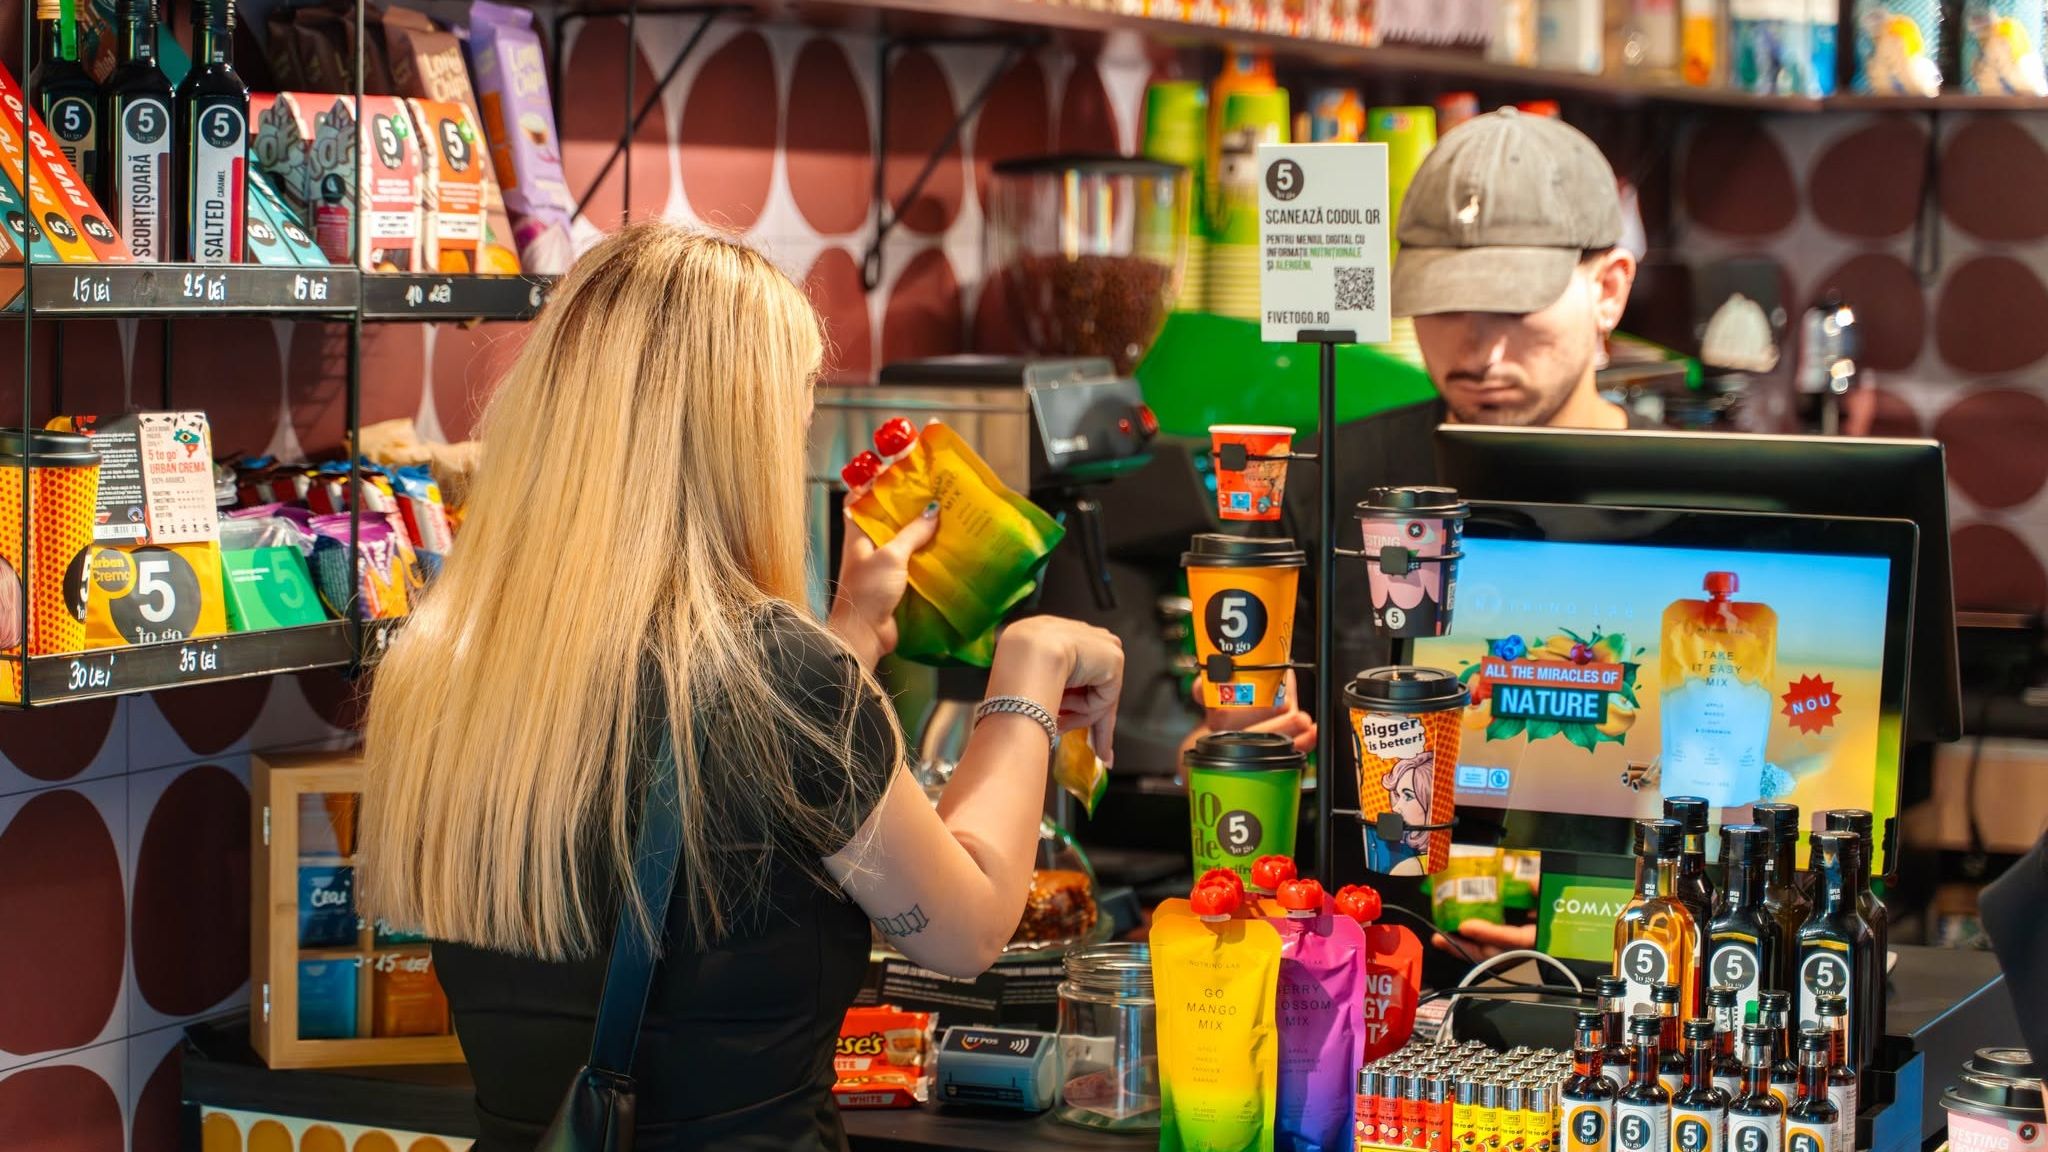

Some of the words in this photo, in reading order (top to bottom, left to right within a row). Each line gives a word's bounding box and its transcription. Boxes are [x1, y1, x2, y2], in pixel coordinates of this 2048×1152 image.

[64, 105, 80, 130] 5
[138, 108, 154, 132] 5
[213, 113, 230, 137] 5
[377, 117, 397, 156] 5
[444, 121, 465, 159] 5
[47, 162, 89, 208] FIVE
[1277, 163, 1294, 191] 5
[1265, 207, 1323, 224] SCANEAZĂ
[1326, 209, 1362, 225] CODUL
[1365, 209, 1381, 225] QR
[205, 200, 225, 258] SALTED
[1266, 234, 1294, 245] PENTRU
[1296, 234, 1324, 245] MENIUL
[1325, 234, 1353, 245] DIGITAL
[1354, 234, 1366, 245] CU
[73, 277, 91, 303] 15
[184, 273, 205, 298] 25
[294, 274, 309, 300] 15
[1267, 310, 1330, 324] FIVETOGO.RO
[149, 462, 177, 474] URBAN
[178, 461, 207, 473] CREMA
[270, 548, 304, 609] 5
[139, 560, 176, 622] 5
[1220, 597, 1248, 638] 5
[1391, 611, 1399, 624] 5
[136, 626, 157, 643] to
[162, 628, 183, 643] go
[1219, 638, 1233, 651] to
[1236, 641, 1251, 654] go
[1703, 651, 1734, 659] TAKE
[179, 648, 197, 672] 35
[1692, 663, 1702, 672] IT
[1709, 665, 1742, 674] EASY
[68, 660, 87, 690] 30
[1485, 664, 1507, 678] ALL
[1511, 665, 1534, 680] THE
[1537, 667, 1599, 683] MIRACLES
[1602, 670, 1619, 685] OF
[1705, 679, 1728, 687] MIX
[1501, 687, 1599, 718] NATURE
[1791, 693, 1831, 715] NOU
[1364, 719, 1418, 738] Bigger
[1368, 741, 1377, 751] is
[1379, 732, 1423, 750] better!
[1229, 815, 1249, 845] 5
[1636, 949, 1653, 973] 5
[1726, 955, 1743, 979] 5
[1365, 974, 1393, 996] NG
[1816, 962, 1834, 987] 5
[1204, 988, 1224, 999] GO
[1186, 1002, 1237, 1016] MANGO
[1363, 997, 1391, 1020] GY
[1198, 1019, 1223, 1031] MIX
[1285, 1017, 1310, 1027] MIX
[980, 1037, 999, 1046] POS
[1367, 1022, 1381, 1045] T
[1581, 1115, 1597, 1136] 5
[1626, 1119, 1640, 1141] 5
[1683, 1124, 1698, 1146] 5
[1743, 1130, 1759, 1152] 5
